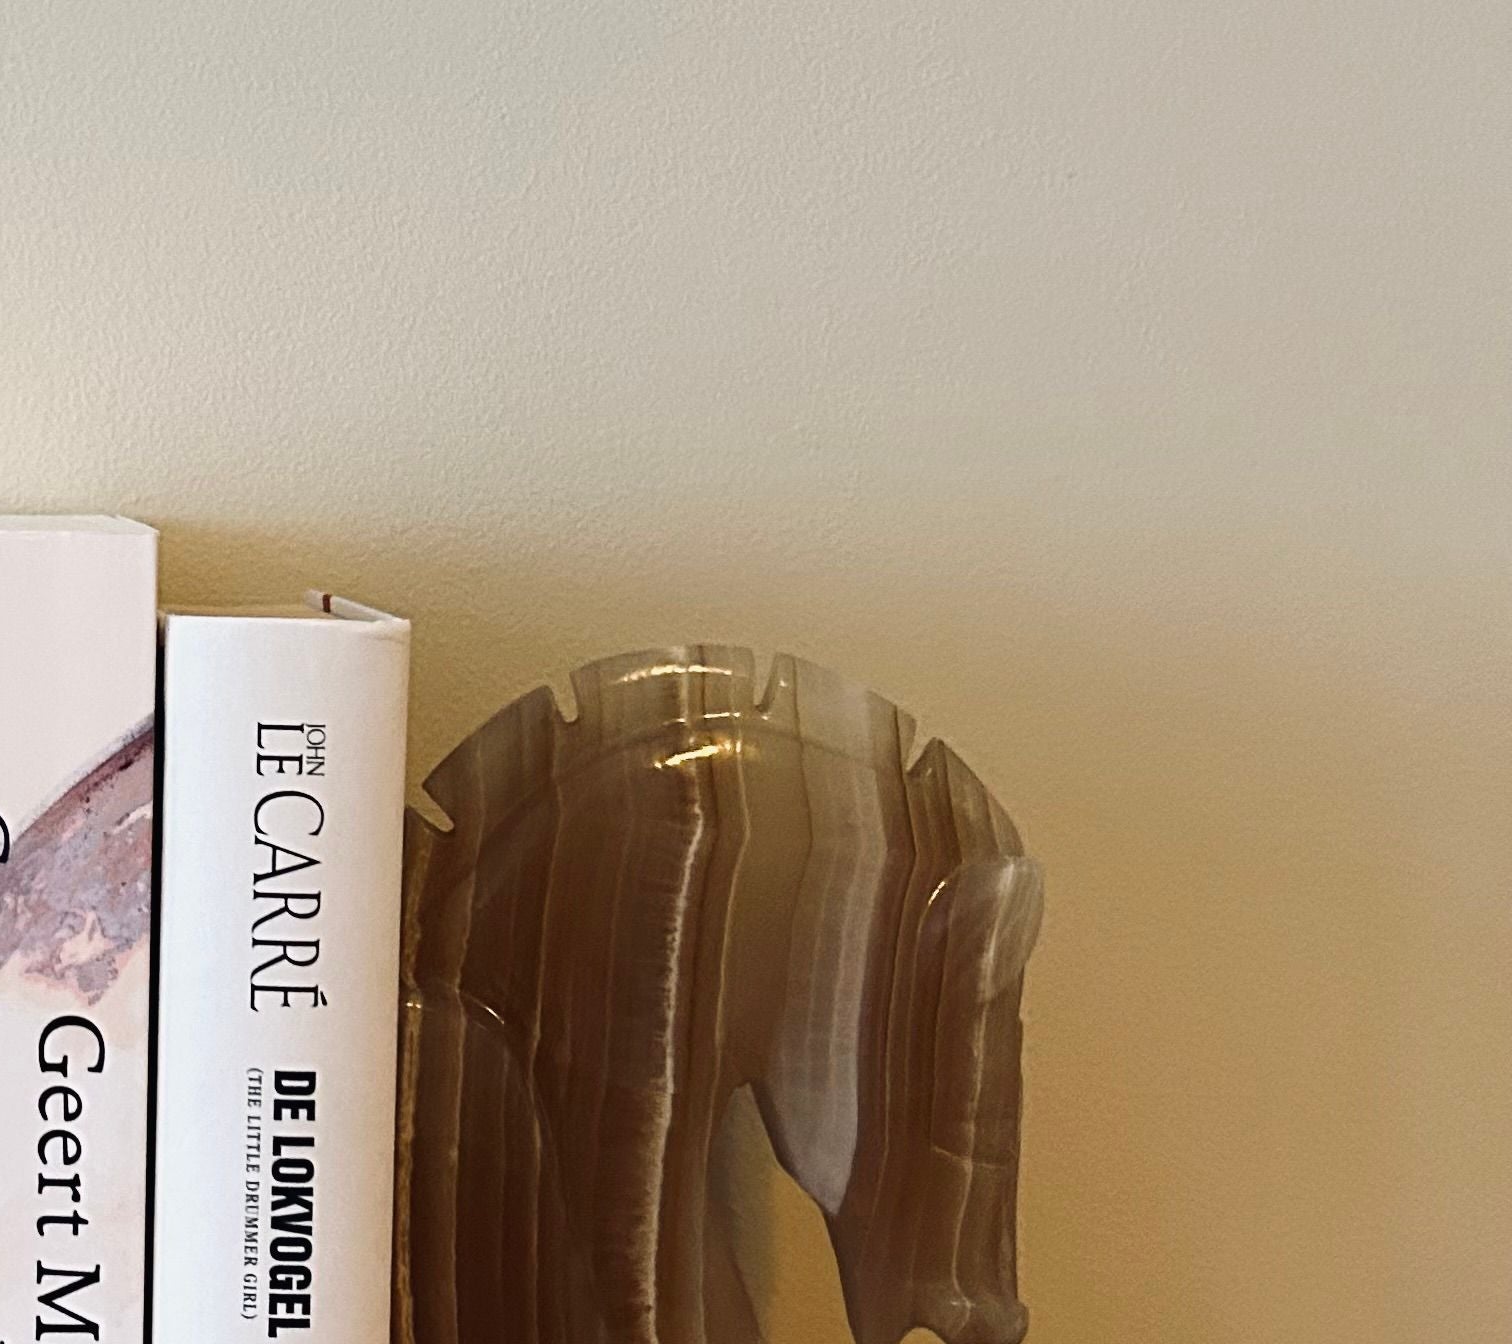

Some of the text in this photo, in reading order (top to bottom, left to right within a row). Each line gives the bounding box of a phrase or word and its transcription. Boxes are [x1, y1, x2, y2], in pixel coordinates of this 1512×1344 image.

[250, 722, 327, 1012] LE CARRÉ
[305, 723, 326, 776] JOHN
[37, 1016, 105, 1236] Geert
[240, 1067, 263, 1320] (THE LITTLE DRUMMER GIRL)
[268, 1071, 316, 1338] DE LOKVOGEL
